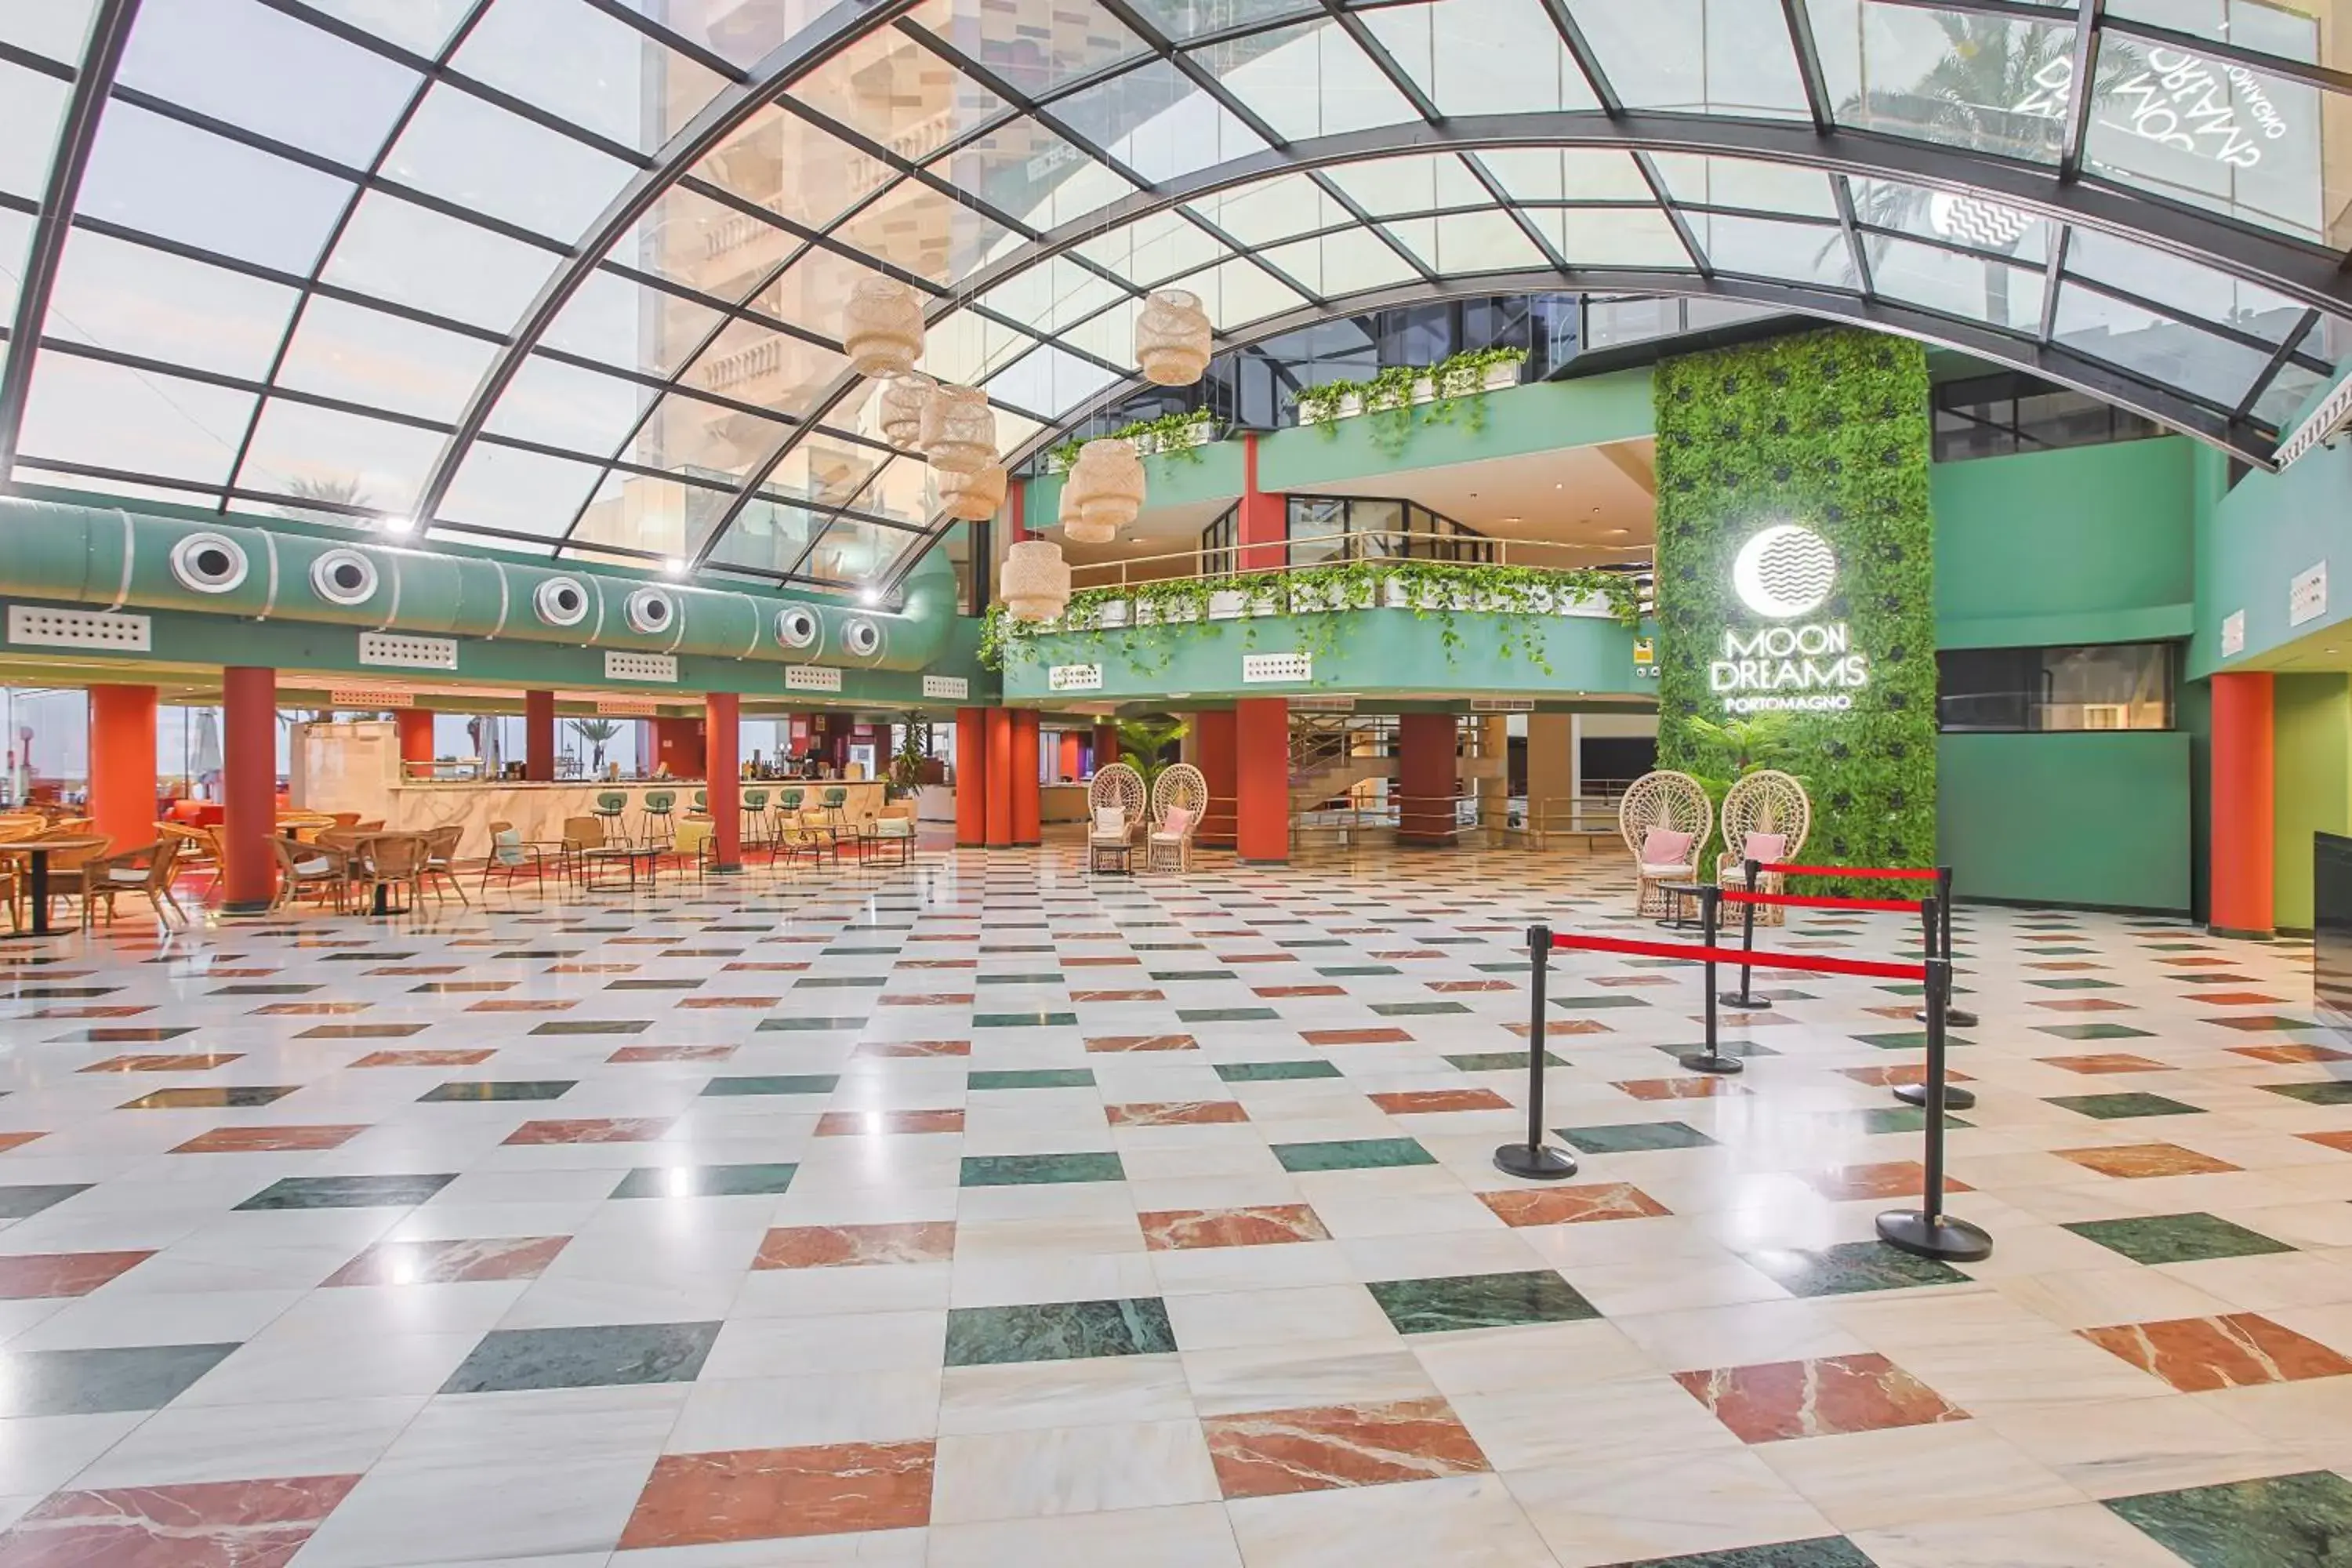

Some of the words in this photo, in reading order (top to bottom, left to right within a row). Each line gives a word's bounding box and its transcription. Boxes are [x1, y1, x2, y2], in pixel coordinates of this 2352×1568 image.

[1726, 624, 1848, 659] MOON
[1710, 655, 1867, 691] DREAMS
[1725, 695, 1851, 713] PORTOMAGNO
